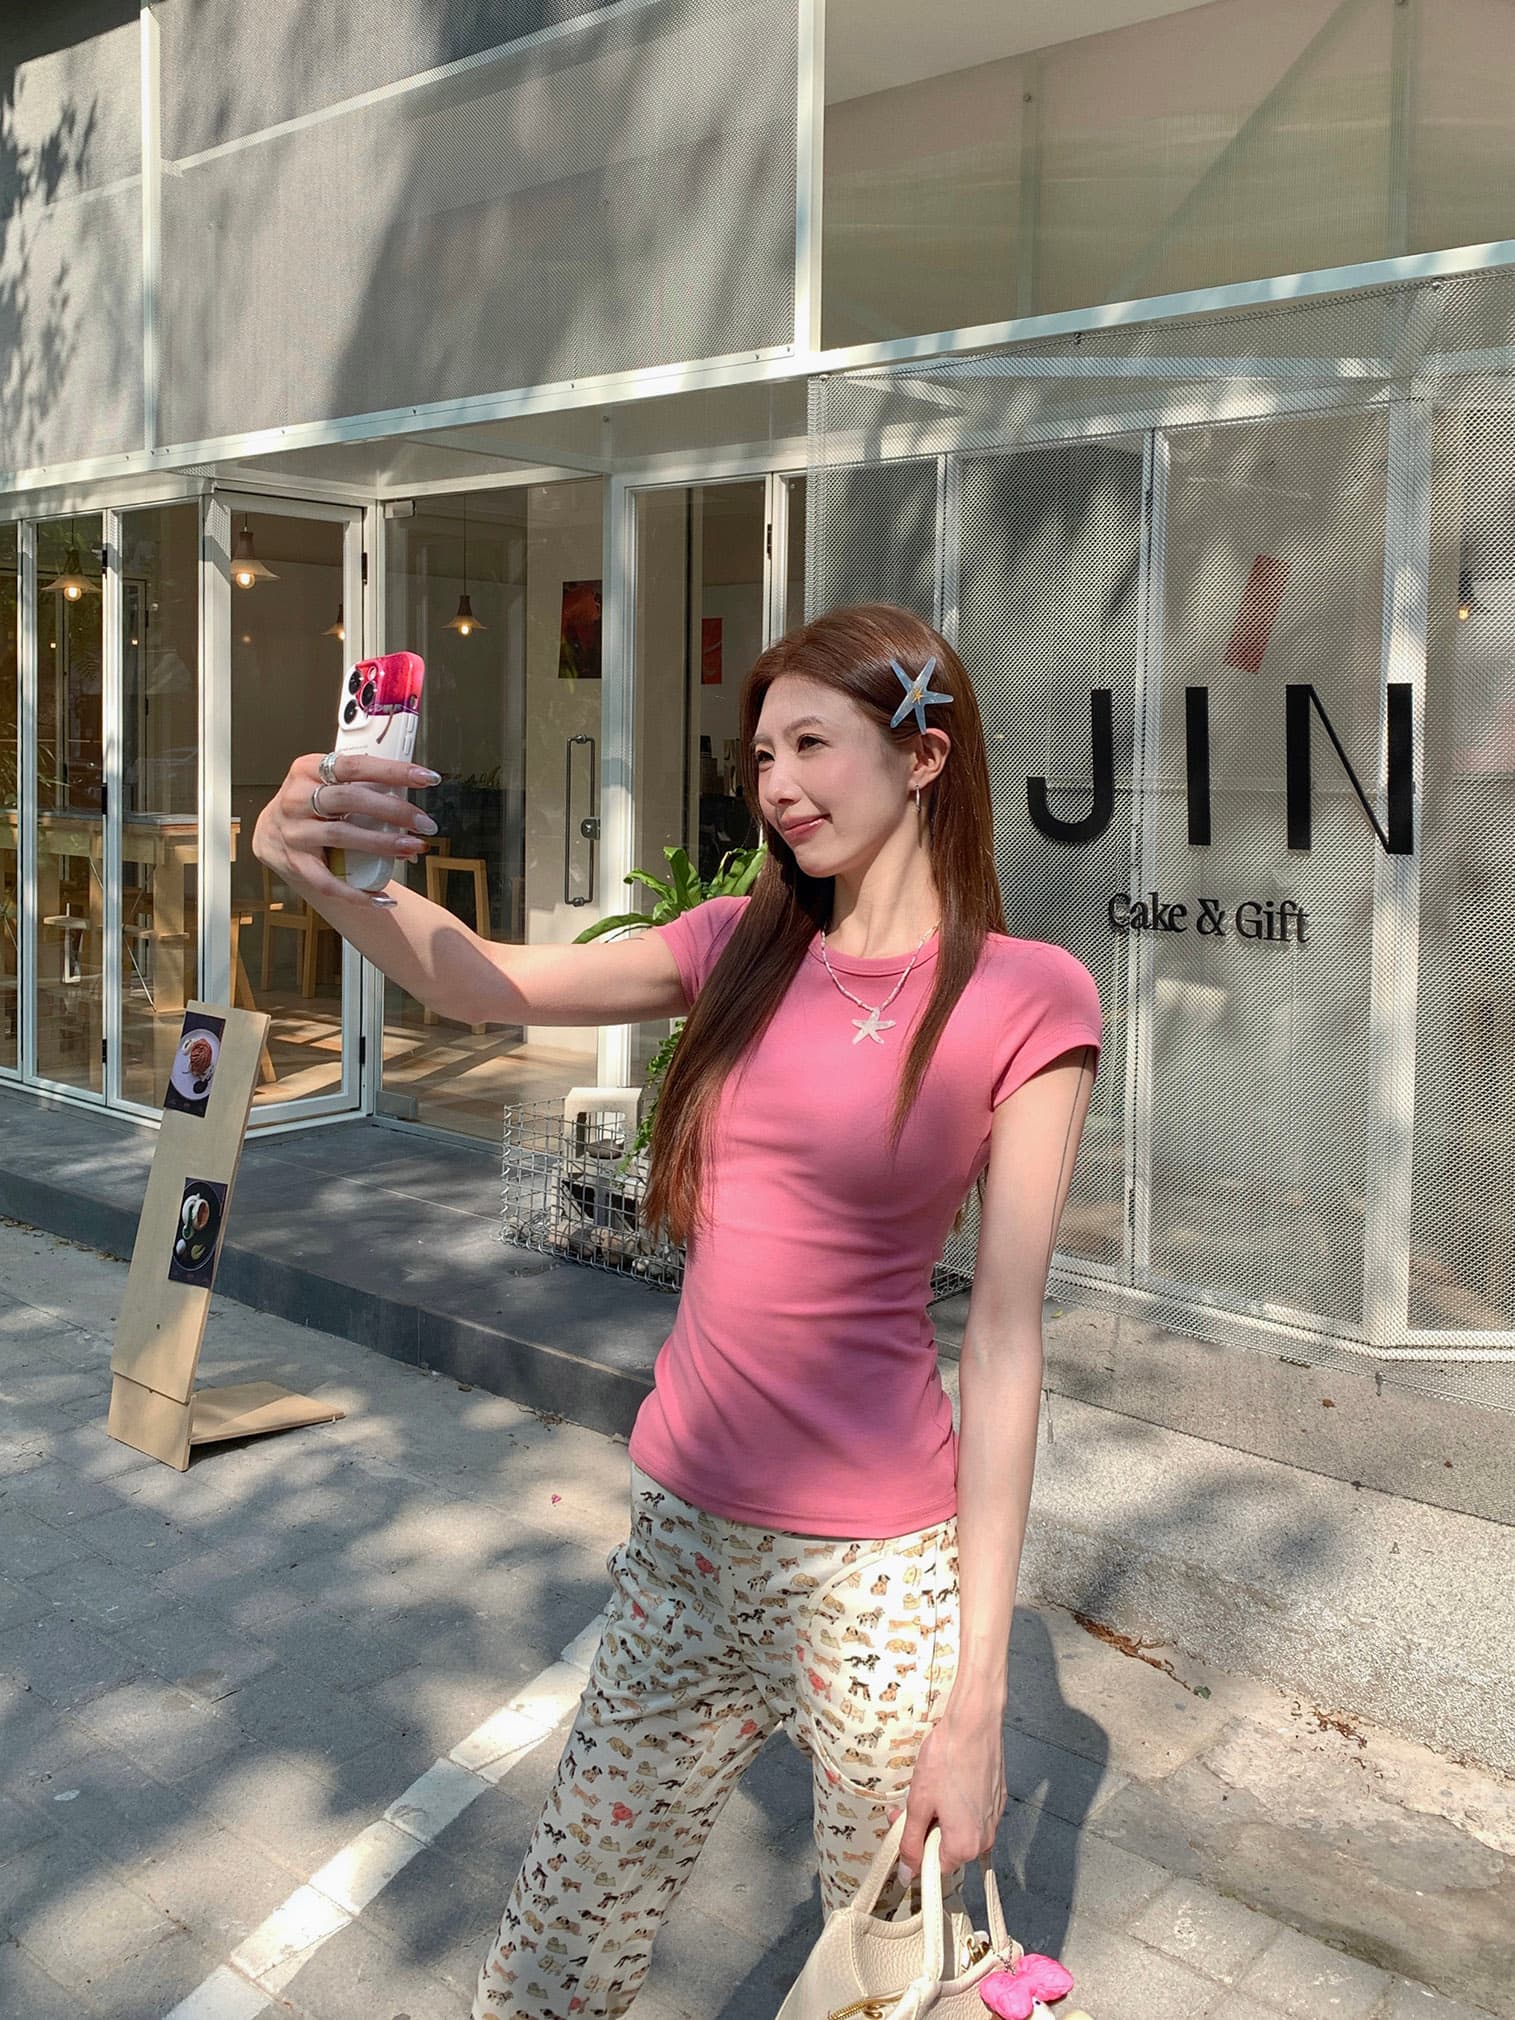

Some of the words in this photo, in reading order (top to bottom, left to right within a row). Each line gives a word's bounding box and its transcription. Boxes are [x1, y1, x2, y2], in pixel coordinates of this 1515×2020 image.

[1026, 682, 1414, 855] JIN
[1108, 891, 1188, 933] Cake
[1196, 898, 1226, 936] &
[1235, 900, 1310, 943] Gift
